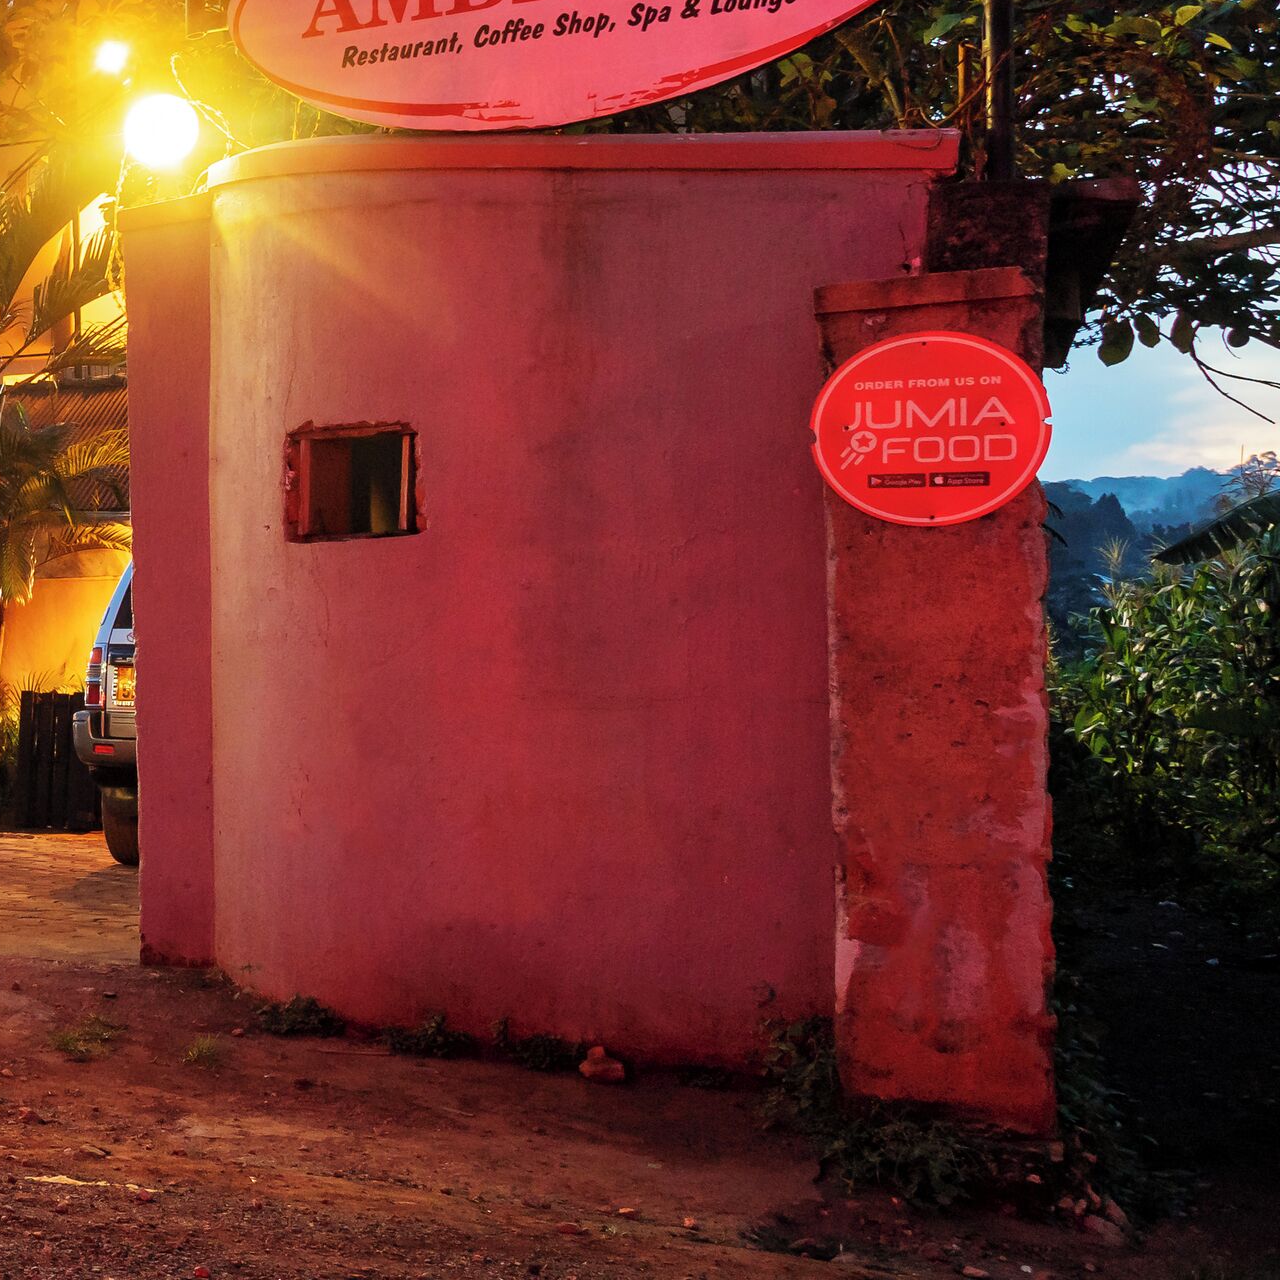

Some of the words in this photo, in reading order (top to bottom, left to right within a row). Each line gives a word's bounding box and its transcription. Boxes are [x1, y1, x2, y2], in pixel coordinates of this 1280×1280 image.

[341, 32, 463, 68] Restaurant,
[474, 18, 544, 48] Coffee
[552, 11, 616, 38] Shop,
[627, 3, 671, 31] Spa
[854, 380, 903, 391] ORDER
[908, 378, 950, 389] FROM
[954, 377, 975, 387] US
[980, 376, 1001, 385] ON
[842, 396, 1015, 432] JUMIA
[882, 434, 1017, 463] FOOD
